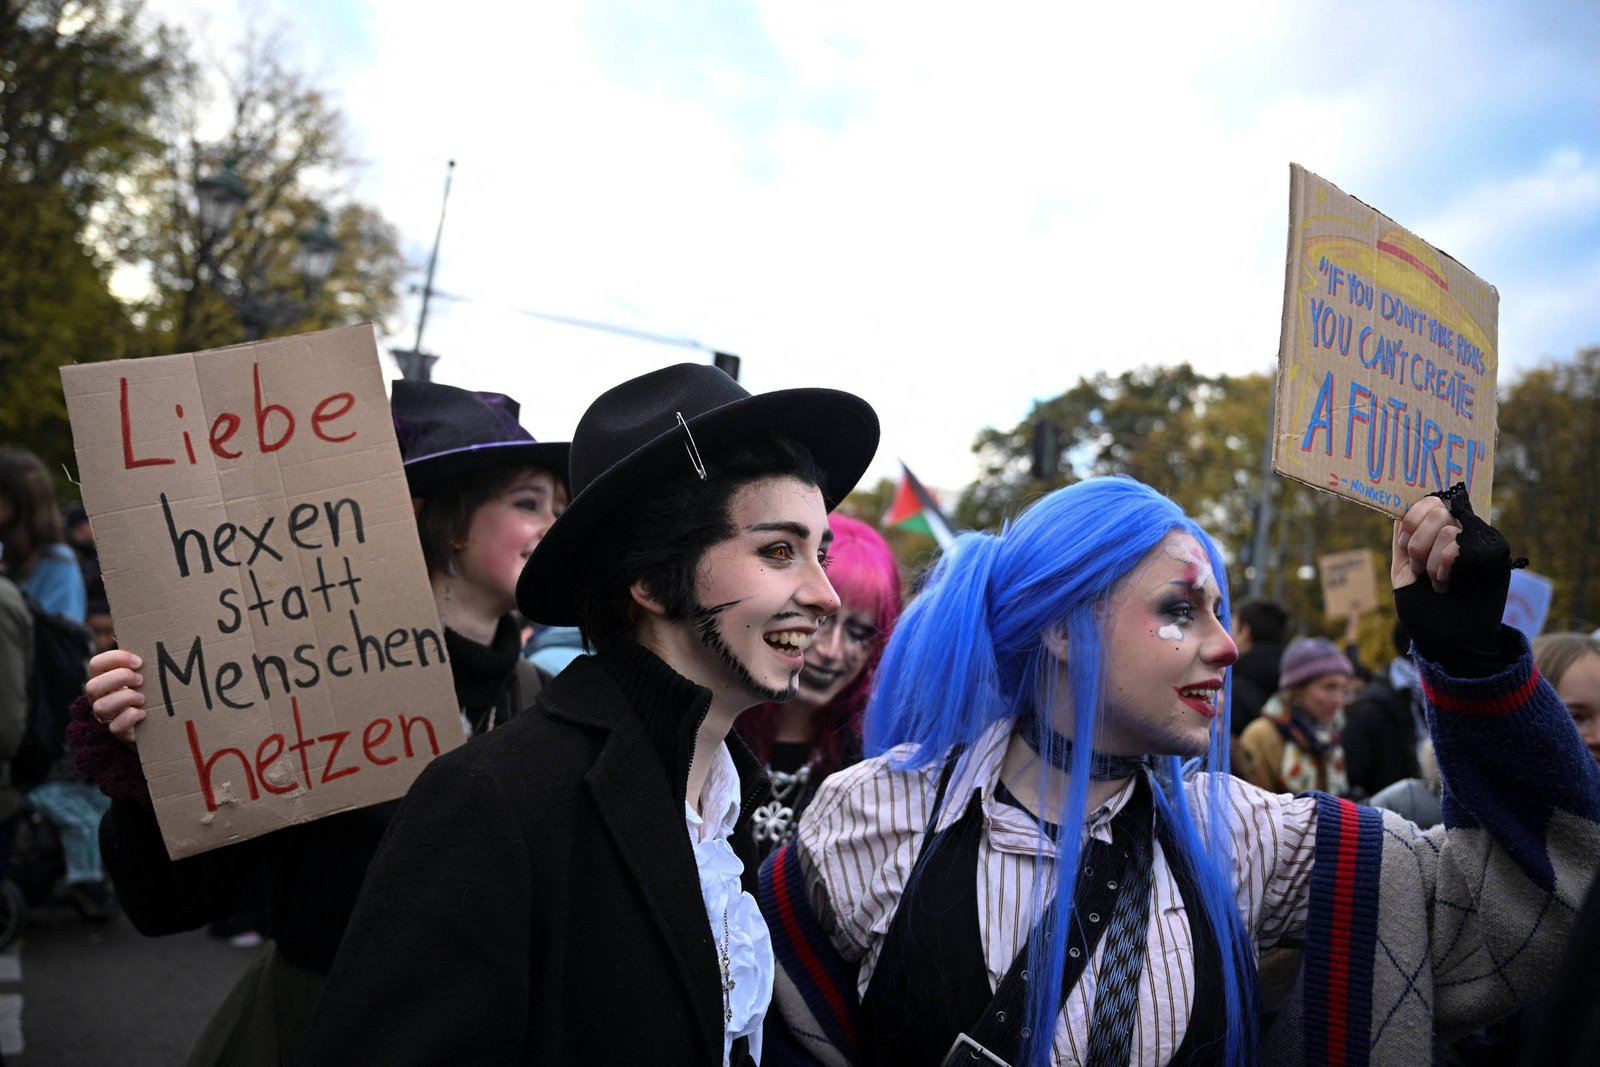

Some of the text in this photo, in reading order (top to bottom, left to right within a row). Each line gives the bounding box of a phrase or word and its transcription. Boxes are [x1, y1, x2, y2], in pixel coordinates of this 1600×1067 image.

[1311, 298, 1475, 420] YOU CAN'T CREATE
[1347, 272, 1374, 311] YOU
[1381, 292, 1426, 336] DON'T
[1428, 319, 1454, 356] TAKE
[120, 362, 357, 469] Liebe
[1300, 370, 1334, 457] A
[160, 492, 366, 577] hexen
[217, 556, 362, 634] statt
[156, 610, 447, 716] Menschen
[185, 696, 440, 812] hetzen
